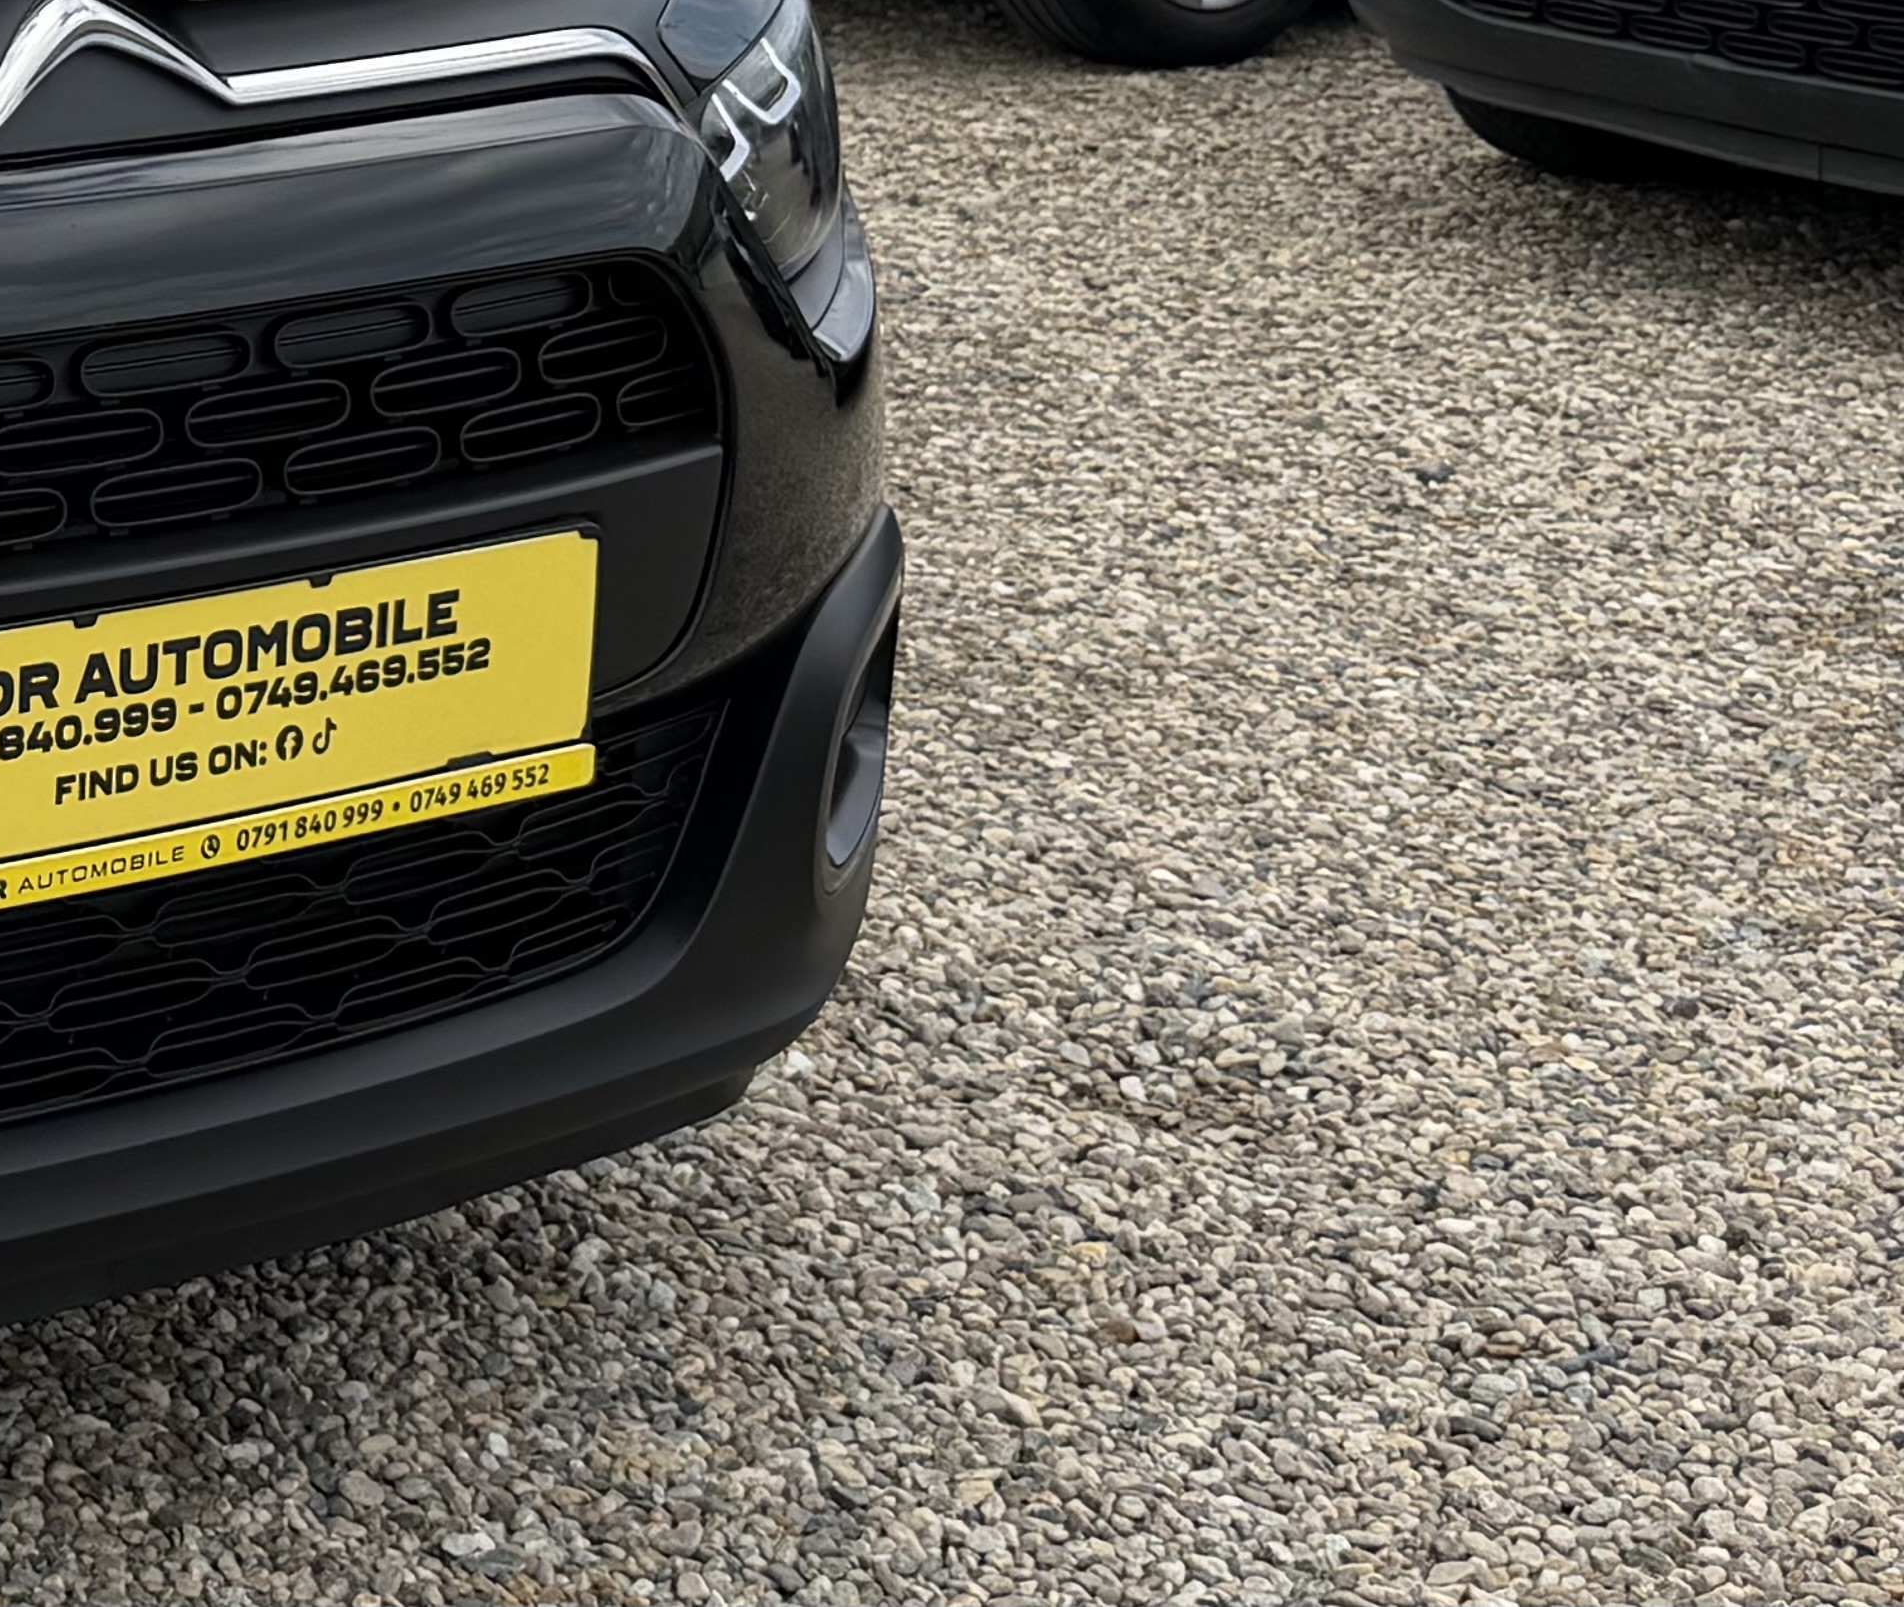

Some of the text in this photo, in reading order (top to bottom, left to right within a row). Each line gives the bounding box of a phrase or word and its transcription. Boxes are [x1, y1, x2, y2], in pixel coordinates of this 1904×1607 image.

[74, 589, 461, 705] AUTOMOBILE
[216, 637, 491, 720] 0749.469.552
[55, 740, 268, 806] FIND US ON:
[17, 845, 186, 895] AUTOMOBILE
[236, 822, 289, 853] 0791
[294, 809, 337, 840] 840
[342, 798, 384, 829] 999
[409, 781, 462, 814] 0749
[466, 772, 507, 800] 469
[511, 763, 551, 791] 552
